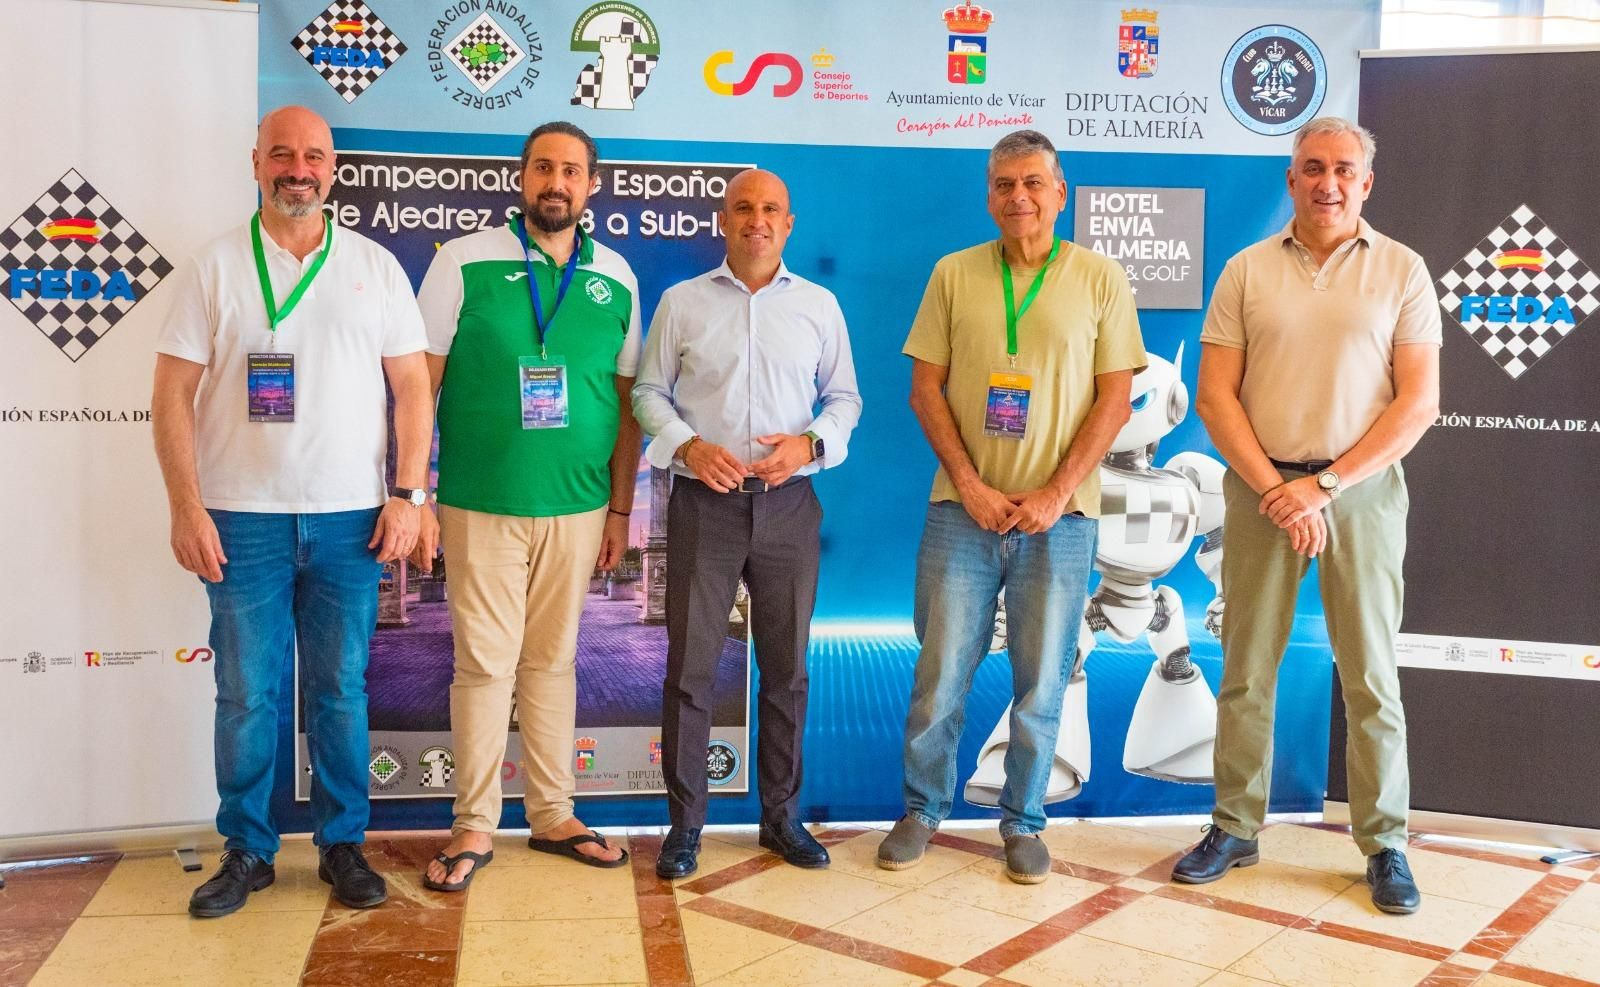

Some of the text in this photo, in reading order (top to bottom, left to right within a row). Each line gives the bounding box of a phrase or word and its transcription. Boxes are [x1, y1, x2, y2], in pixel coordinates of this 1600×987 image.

[485, 0, 542, 63] ANDALUZA
[313, 46, 386, 69] FEDA
[520, 68, 540, 90] DE
[813, 71, 851, 82] Consejo
[814, 81, 853, 91] Superior
[452, 85, 523, 110] AJEDREZ
[813, 91, 869, 102] de Deportes
[886, 90, 1046, 108] Ayuntamiento de Vícar
[1065, 91, 1209, 115] DIPUTACIÓN
[896, 112, 1034, 136] Corazón del Poniente
[1068, 116, 1205, 140] DE ALMERÍA
[1090, 192, 1164, 214] HOTEL
[371, 201, 493, 234] Ajedrez
[606, 212, 629, 236] a
[1142, 265, 1191, 281] GOLF
[10, 268, 137, 301] FEDA
[1460, 295, 1577, 325] FEDA
[39, 407, 129, 422] ESPAÑOLA
[1475, 414, 1560, 431] ESPAÑOLA
[1564, 419, 1587, 432] DE
